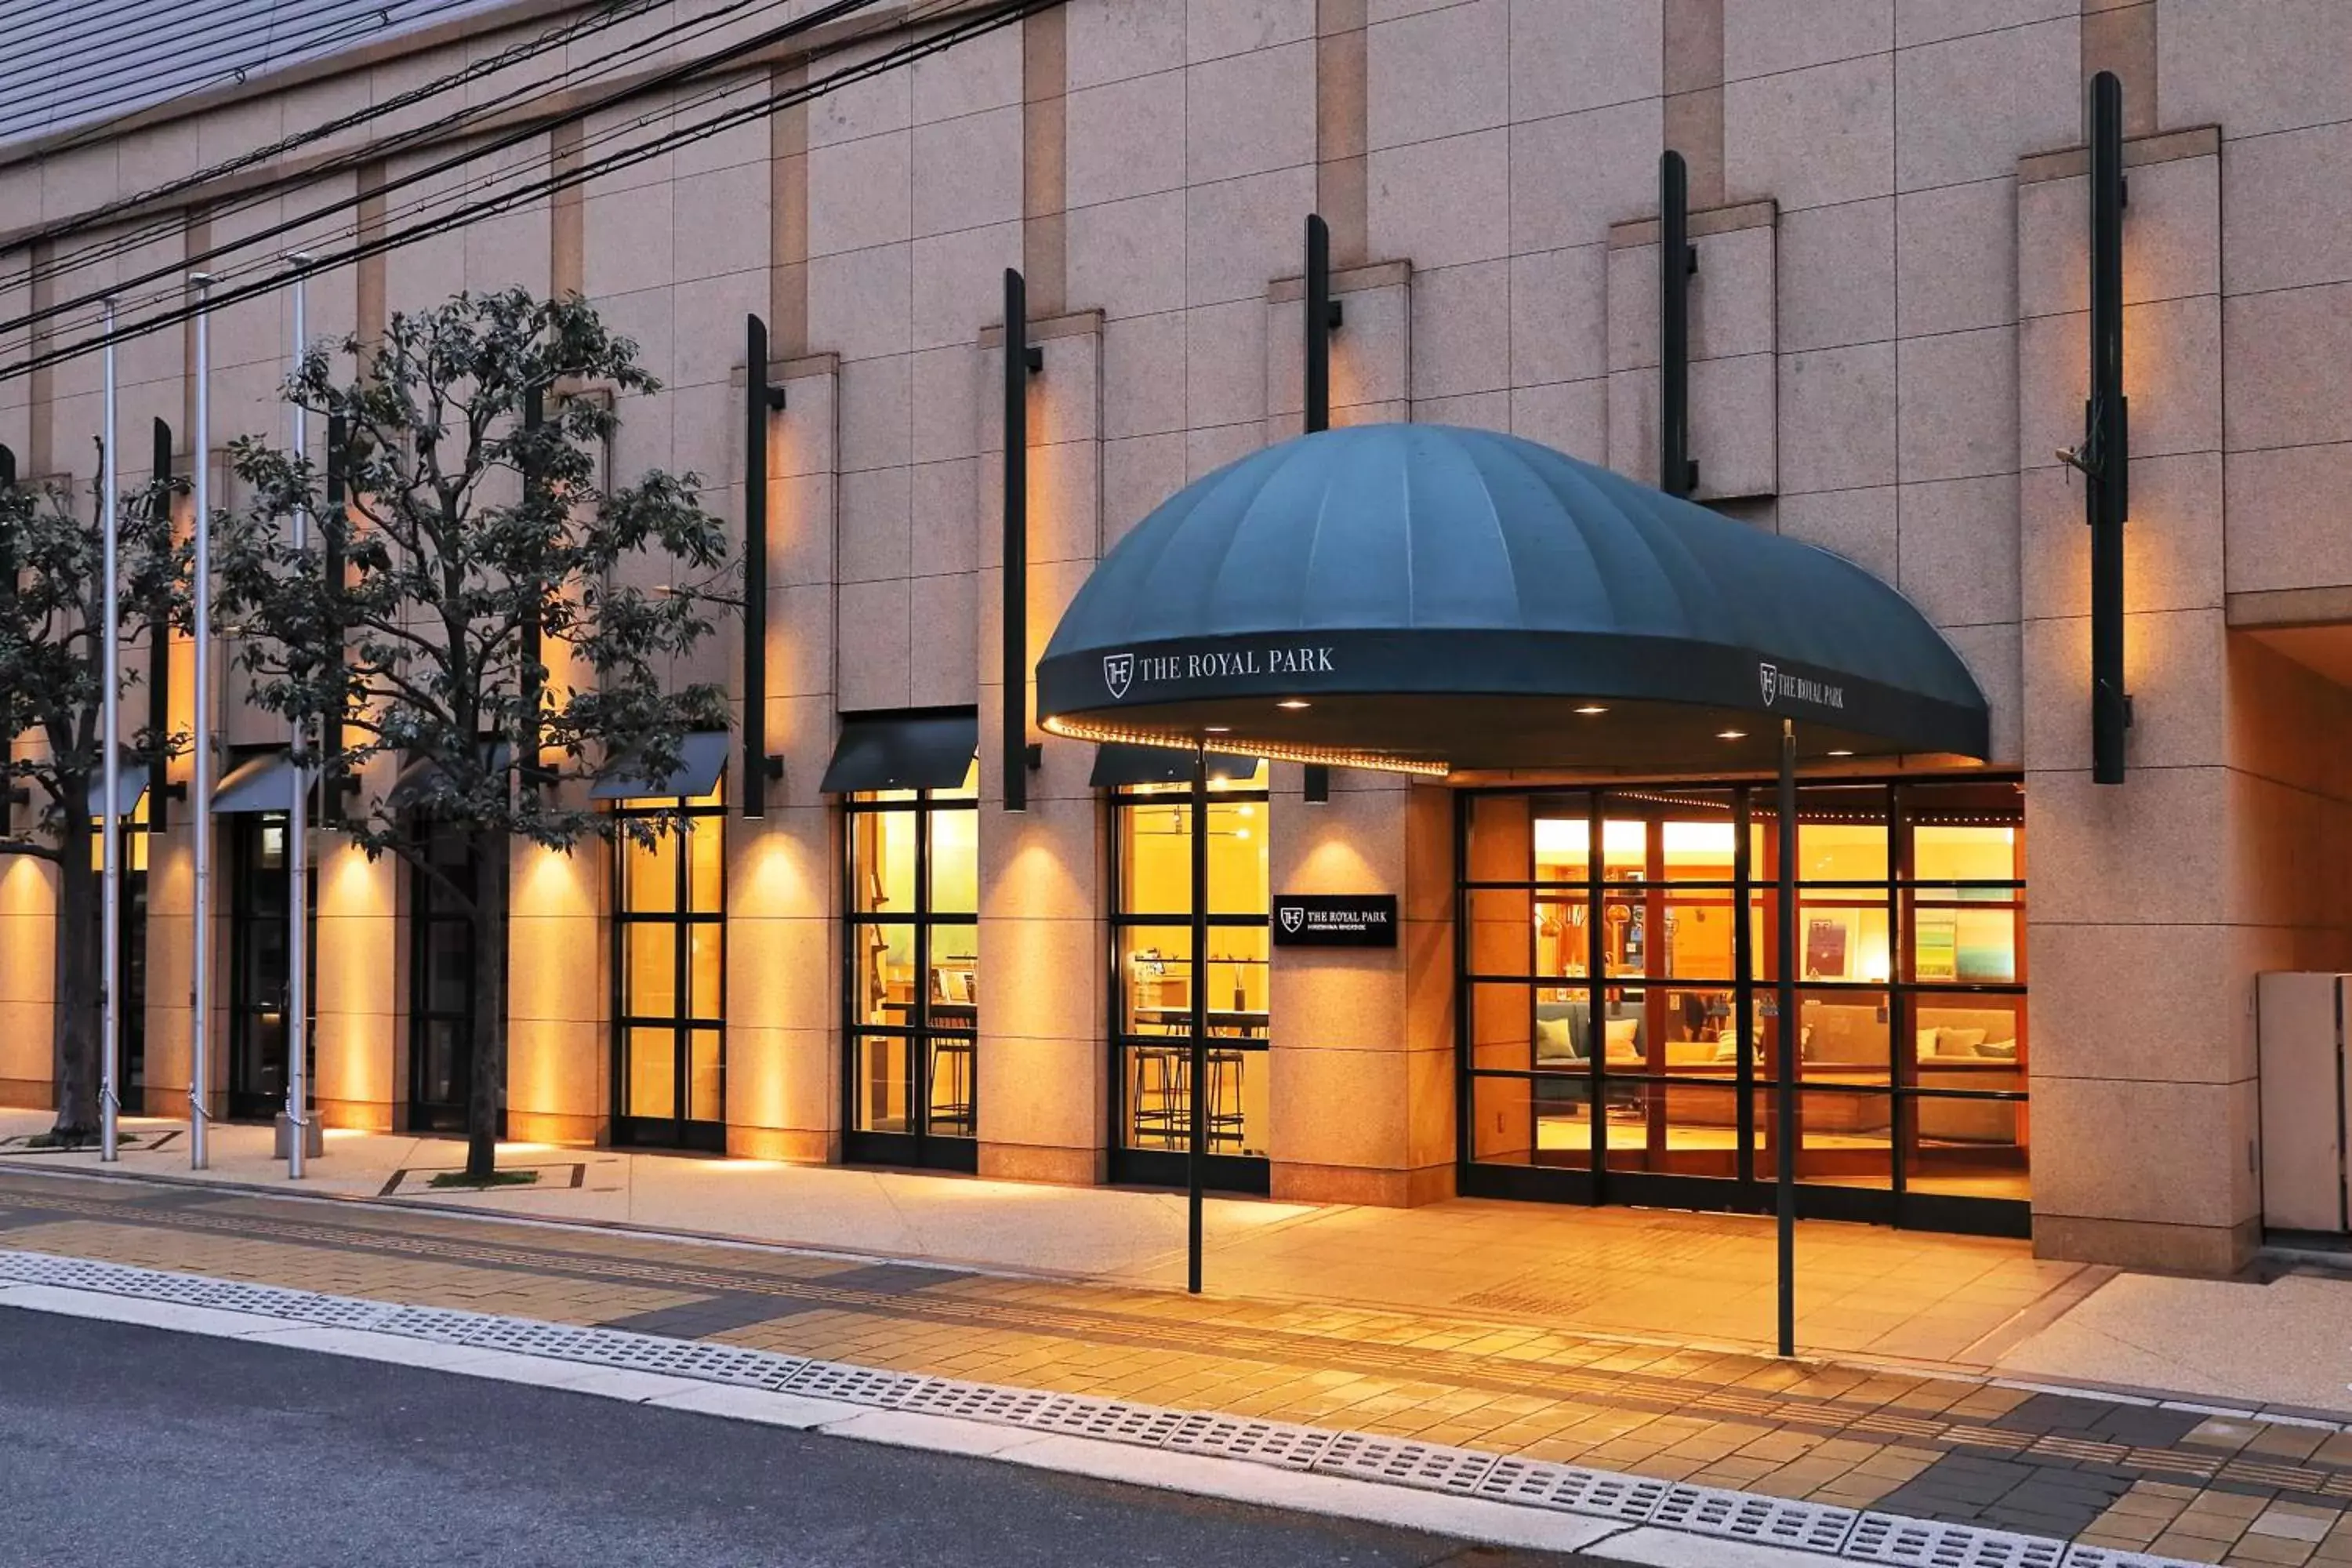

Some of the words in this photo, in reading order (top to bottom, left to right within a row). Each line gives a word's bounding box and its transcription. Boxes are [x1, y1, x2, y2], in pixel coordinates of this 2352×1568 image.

[1139, 656, 1181, 681] THE
[1188, 650, 1260, 678] ROYAL
[1269, 648, 1334, 673] PARK
[1777, 673, 1796, 697] THE
[1307, 911, 1327, 922] THE
[1329, 911, 1360, 923] ROYAL
[1362, 911, 1387, 923] PARK
